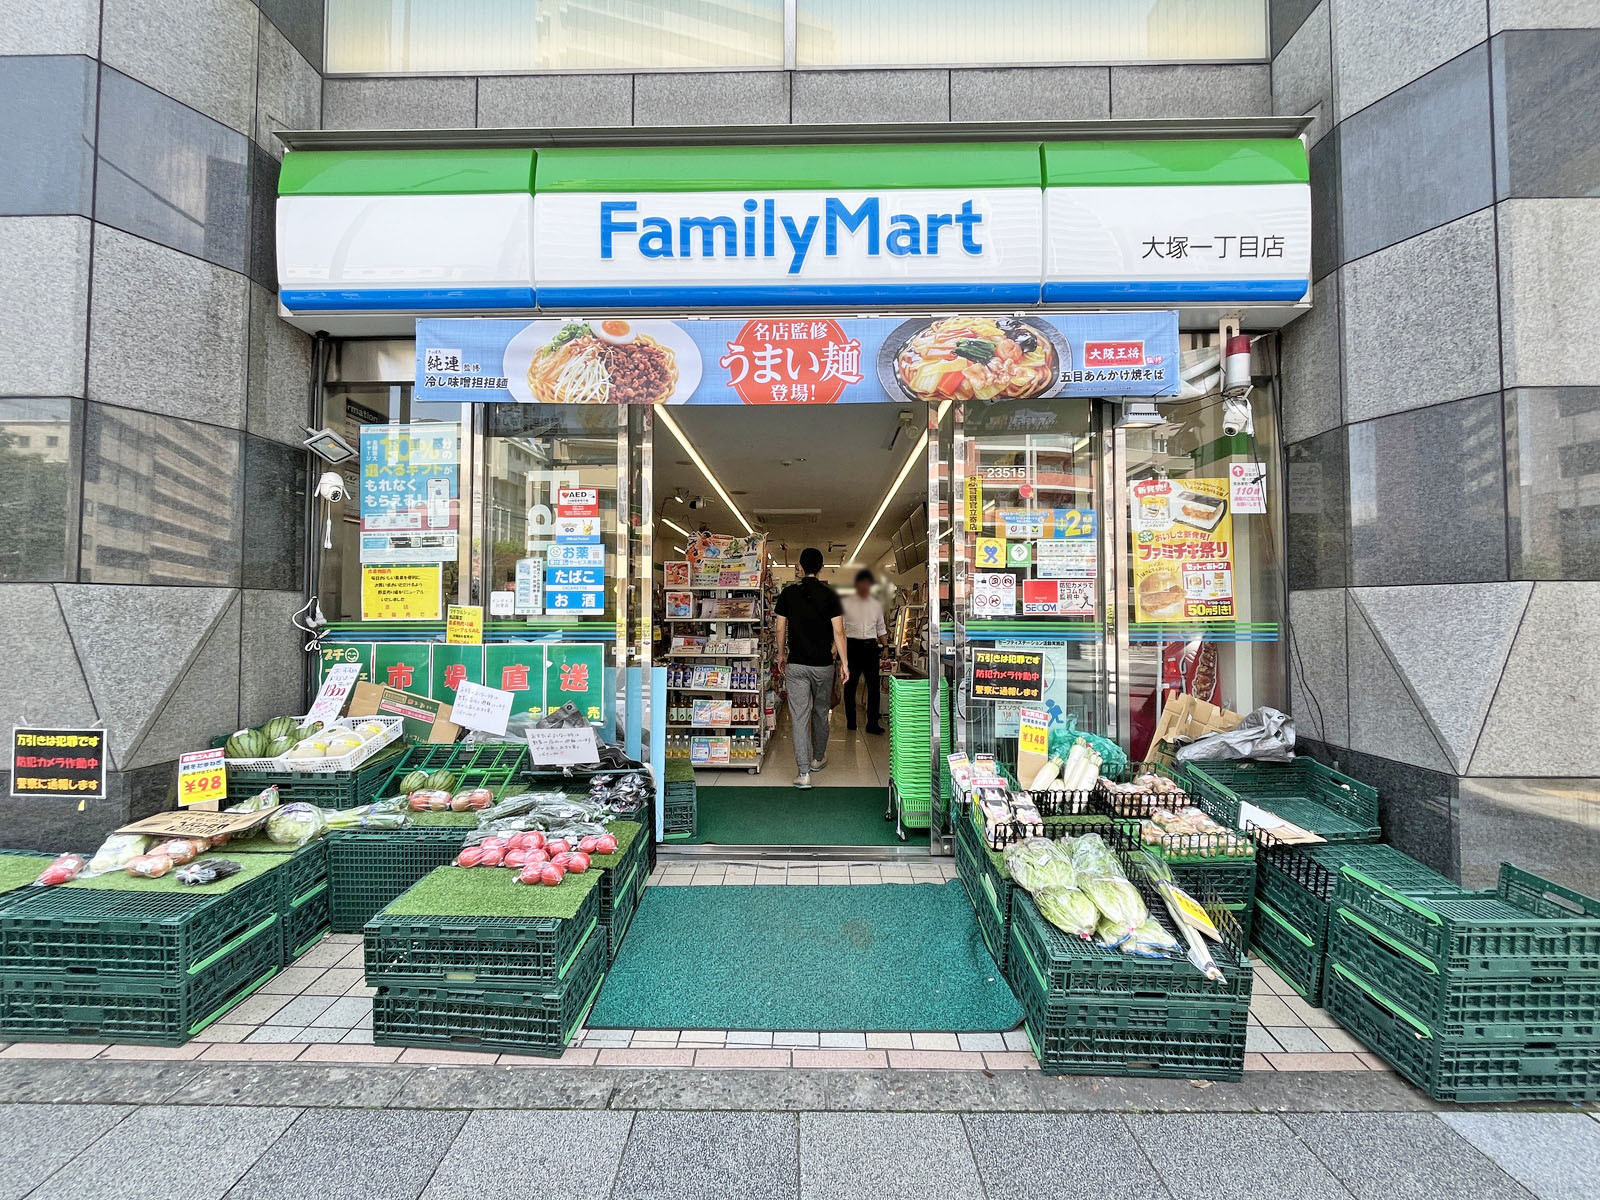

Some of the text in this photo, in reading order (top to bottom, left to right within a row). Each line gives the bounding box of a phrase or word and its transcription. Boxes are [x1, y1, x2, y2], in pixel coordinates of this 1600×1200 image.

[600, 198, 983, 274] FamilyMart
[1141, 234, 1285, 259] 大塚一丁目店
[753, 322, 829, 341] 名店監修
[1088, 347, 1140, 360] 大阪王将
[427, 355, 460, 372] 純連
[721, 340, 864, 386] うまい麺
[424, 375, 509, 389] 冷し味噌担担麺
[1060, 368, 1165, 383] 五目あんかけ焼そば
[987, 468, 1025, 478] 23515
[365, 479, 416, 492] もれなく
[563, 547, 589, 559] お薬
[1138, 541, 1228, 560] ファミチキ祭り
[555, 570, 595, 583] たばこ
[555, 594, 596, 607] お酒
[1187, 604, 1231, 616] 50円引き!
[323, 649, 344, 661] プチ
[977, 652, 1040, 665] 万引きは犯罪です
[976, 669, 1040, 681] 防犯カメラ作動中
[975, 685, 1039, 697] 警察に通報します
[17, 734, 99, 747] 万引きは犯罪です
[1024, 733, 1045, 744] ¥148
[16, 756, 99, 769] 防犯カメラ作動中
[16, 777, 99, 791] 警察に通報します
[185, 776, 221, 792] ¥98
